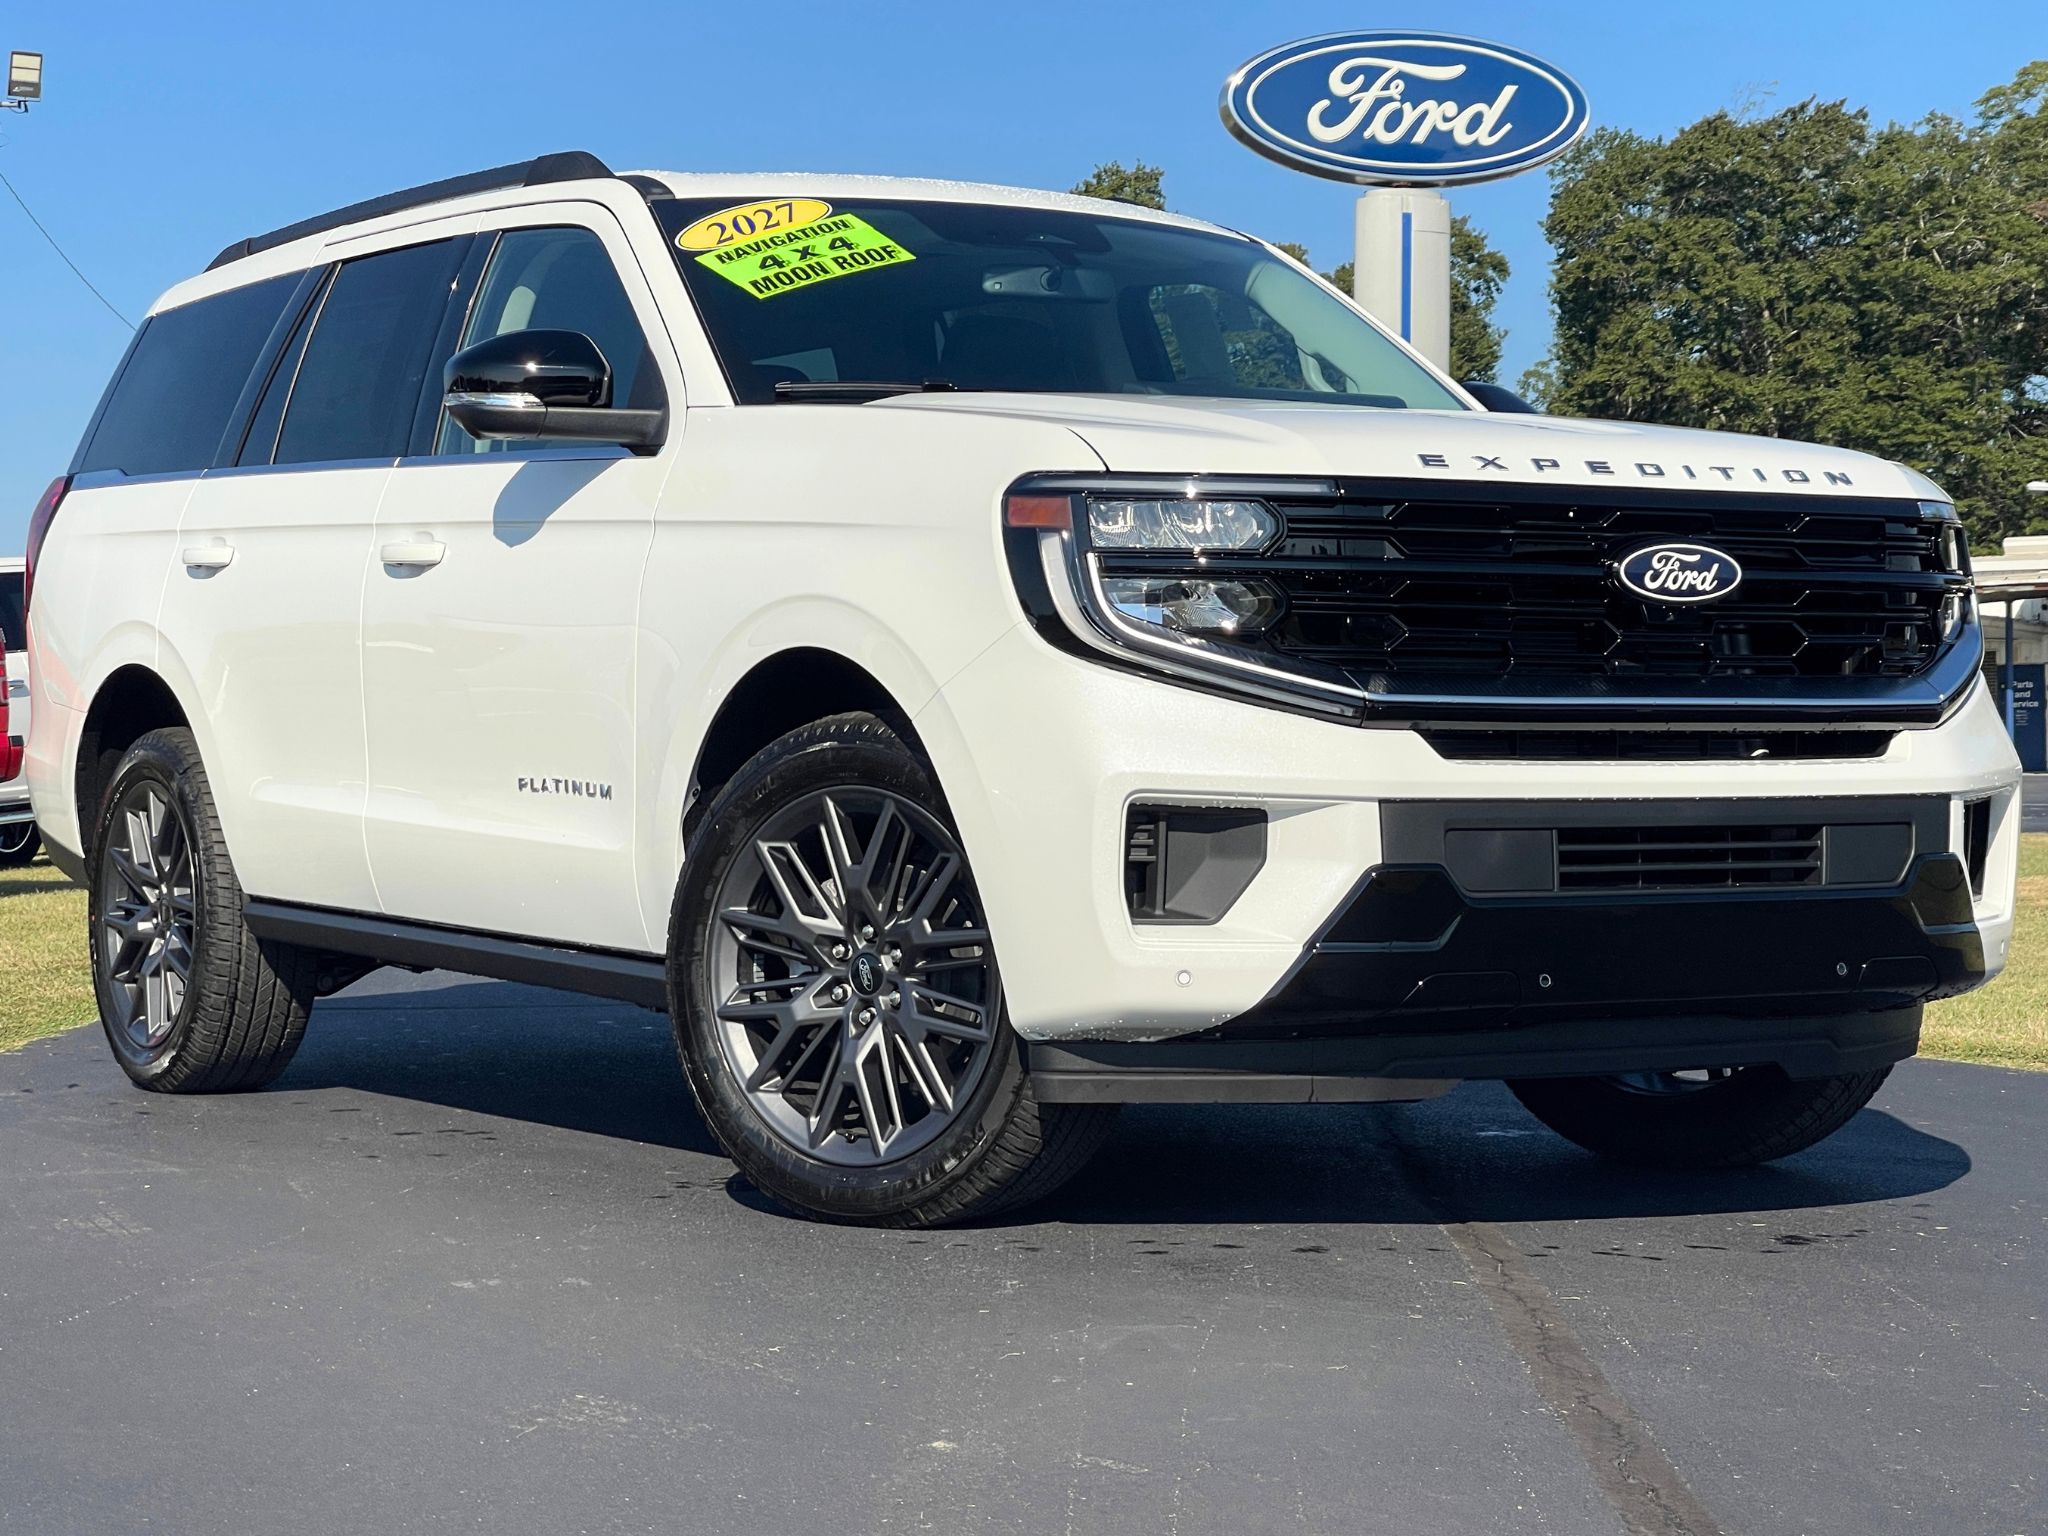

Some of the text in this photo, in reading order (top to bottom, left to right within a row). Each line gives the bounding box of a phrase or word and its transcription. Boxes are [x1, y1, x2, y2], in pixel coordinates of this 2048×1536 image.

[1307, 56, 1519, 147] Ford
[706, 201, 794, 245] 2027
[714, 218, 852, 265] NAVIGATION
[749, 244, 899, 295] MOON ROOF
[758, 253, 786, 271] 4
[828, 235, 854, 252] 4
[1418, 453, 1854, 487] EXPEDITION
[1644, 550, 1721, 592] Ford
[2015, 690, 2031, 698] and
[518, 777, 612, 800] PLATINUM
